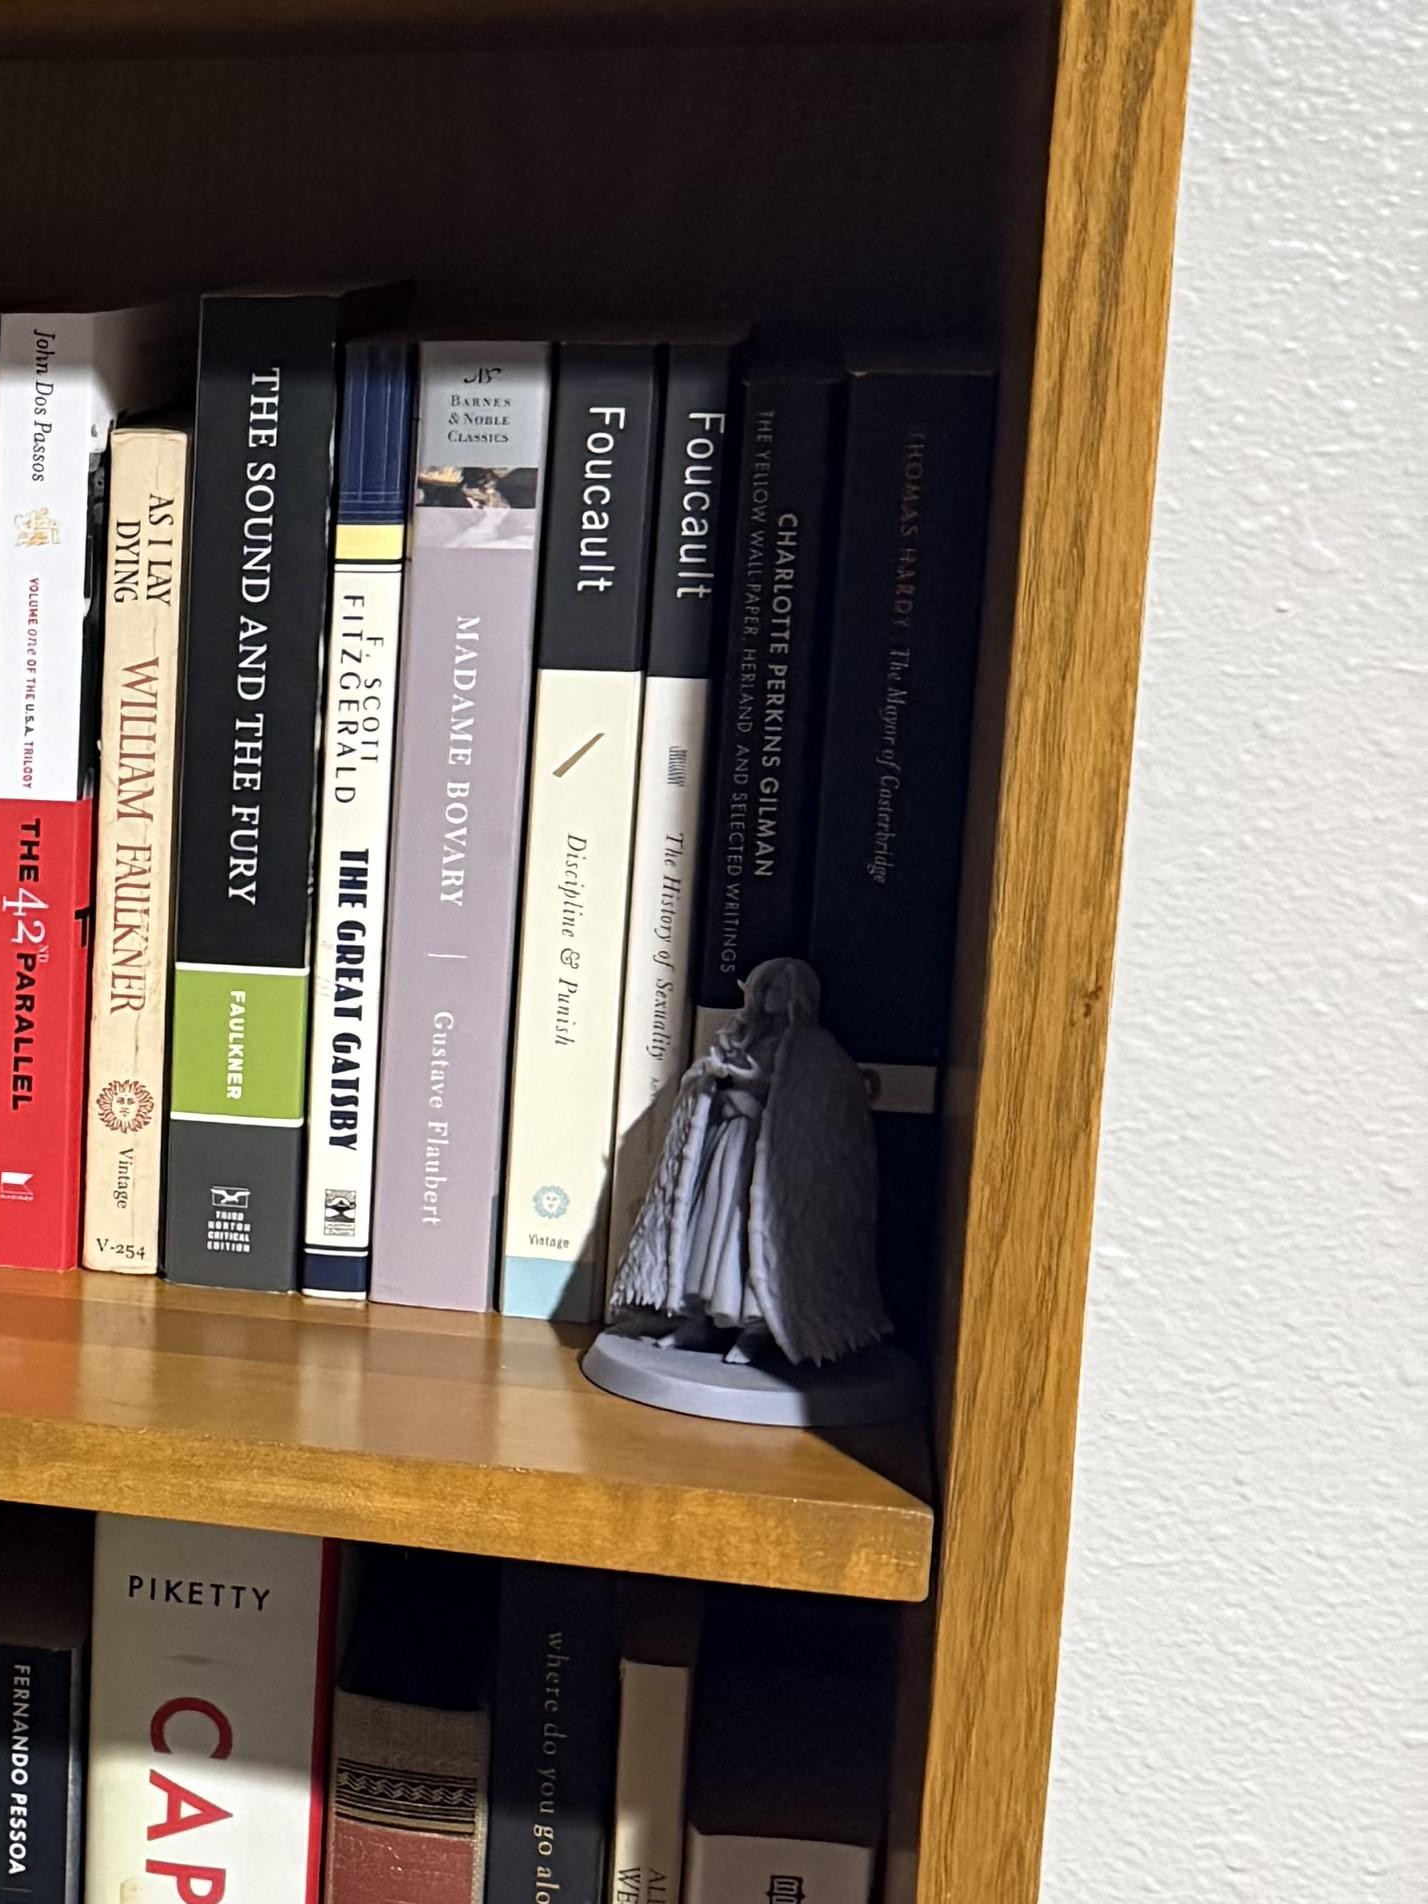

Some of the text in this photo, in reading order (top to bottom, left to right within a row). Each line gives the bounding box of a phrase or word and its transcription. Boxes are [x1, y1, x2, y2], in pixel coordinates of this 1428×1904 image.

[576, 405, 626, 593] Foucault
[676, 412, 726, 599] Foucault
[18, 818, 41, 883] THE
[109, 655, 160, 1014] WILLIAM FAULKNER
[337, 848, 370, 909] THE
[333, 919, 367, 1020] GREAT
[12, 952, 37, 1111] PARALLEL
[226, 990, 246, 1101] FAULKNER
[328, 1031, 362, 1152] GATSBY
[114, 1147, 135, 1209] Vintage
[96, 1237, 146, 1260] V-254
[128, 1575, 272, 1611] PIKETTY
[7, 1664, 32, 1875] FERNANDO PESSOA
